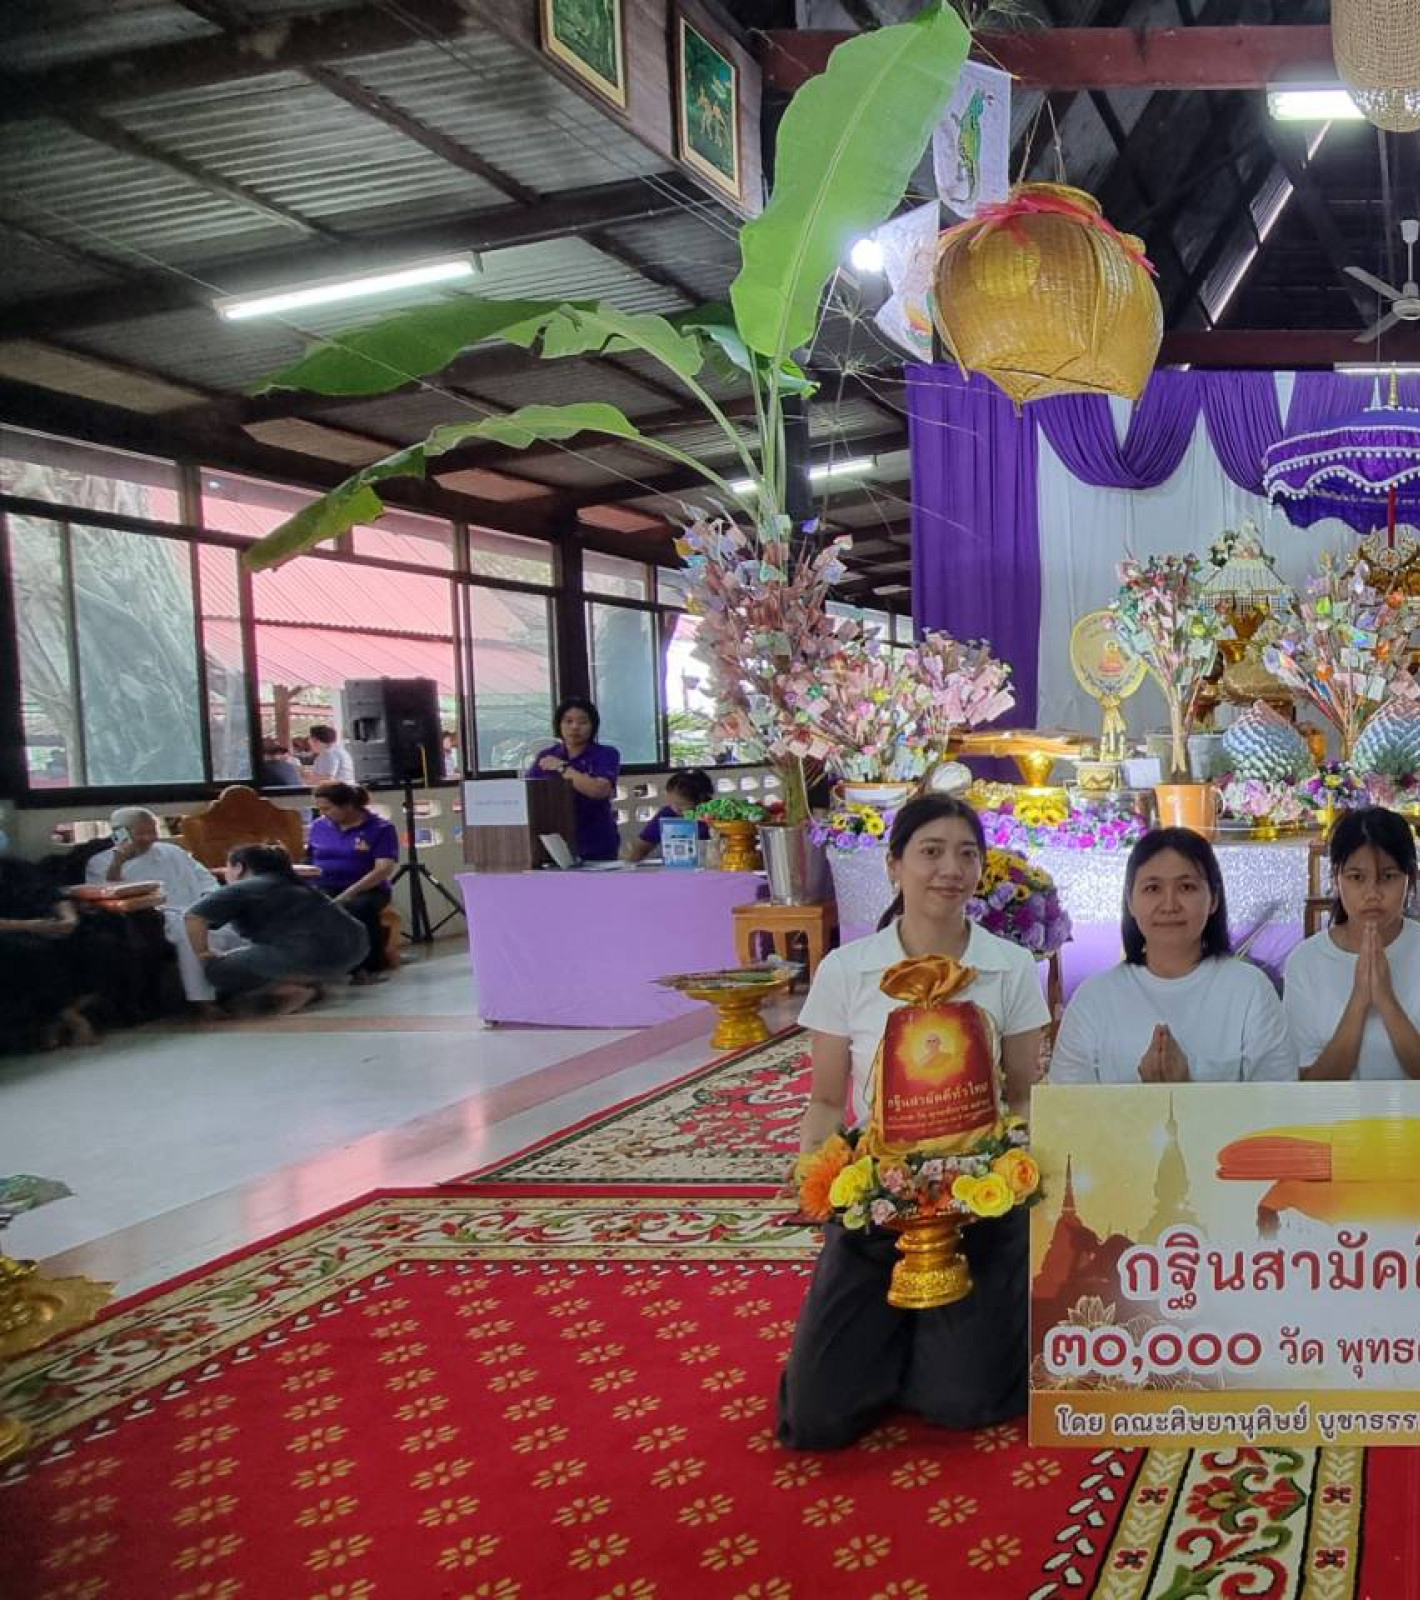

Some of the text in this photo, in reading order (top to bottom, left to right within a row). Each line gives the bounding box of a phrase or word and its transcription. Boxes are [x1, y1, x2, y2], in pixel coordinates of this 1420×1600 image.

[1051, 1332, 1263, 1376] ๓๐,๐๐๐
[1278, 1324, 1324, 1365] วัด
[1057, 1406, 1102, 1432] โดย
[1113, 1405, 1308, 1440] คณะศิษยานุศิษย์
